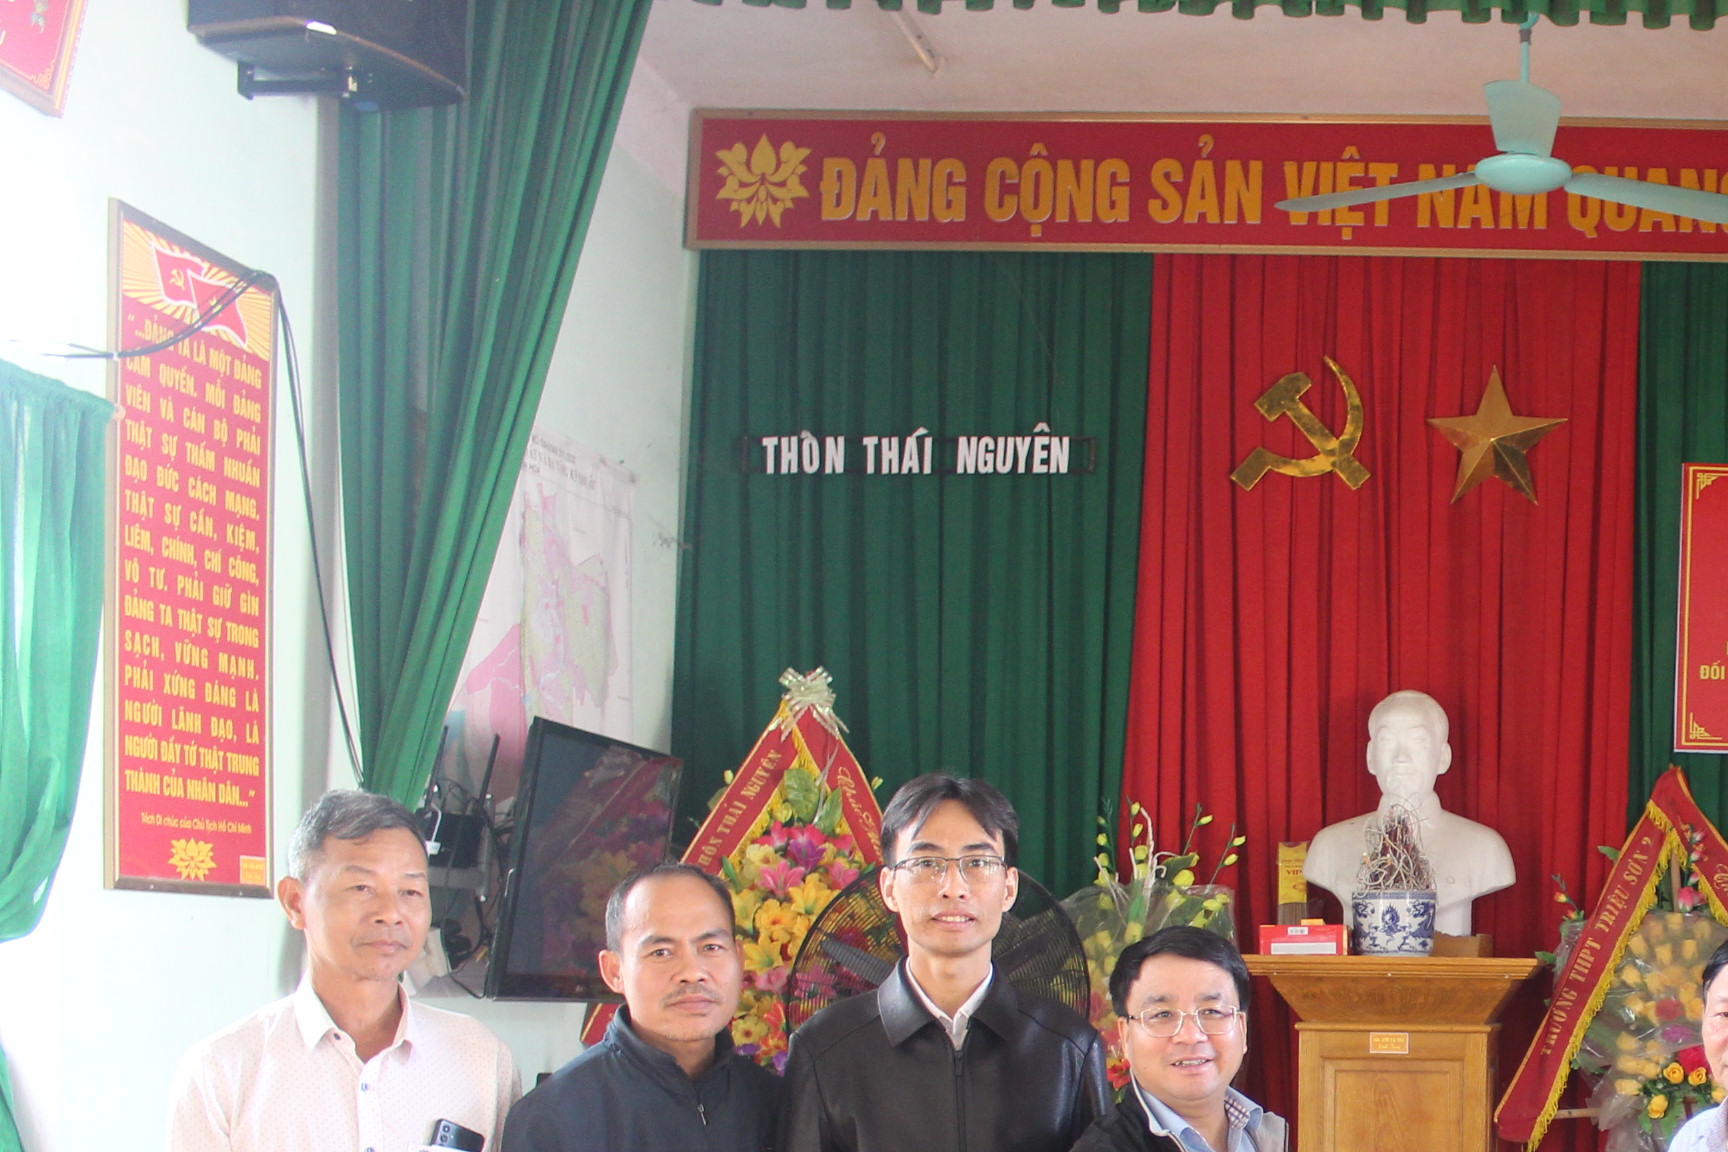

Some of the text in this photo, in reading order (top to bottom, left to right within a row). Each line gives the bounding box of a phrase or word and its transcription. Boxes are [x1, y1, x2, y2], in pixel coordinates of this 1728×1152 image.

[820, 132, 967, 223] ĐẢNG
[985, 143, 1131, 237] CỘNG
[1150, 135, 1263, 226] SẢN
[1285, 147, 1397, 240] VIỆT
[1417, 164, 1548, 229] NAM
[125, 383, 261, 456] VIÊN VÀ CÁN BỘ PHẢI
[762, 422, 1069, 474] THÔN THÁI NGUYÊN
[124, 557, 260, 617] VÔ TƯ. PHẢI GIỮ GÌN
[124, 587, 259, 648] ĐẢNG TA THẬT SỰ TRONG
[124, 629, 259, 681] SẠCH, VỮNG MẠNH.
[1700, 661, 1725, 679] ĐỐI
[698, 749, 782, 866] HÔN THÁI NGUYÊN
[1569, 937, 1601, 983] THPT
[1595, 885, 1629, 933] TRIỆU
[1624, 850, 1649, 885] SƠN
